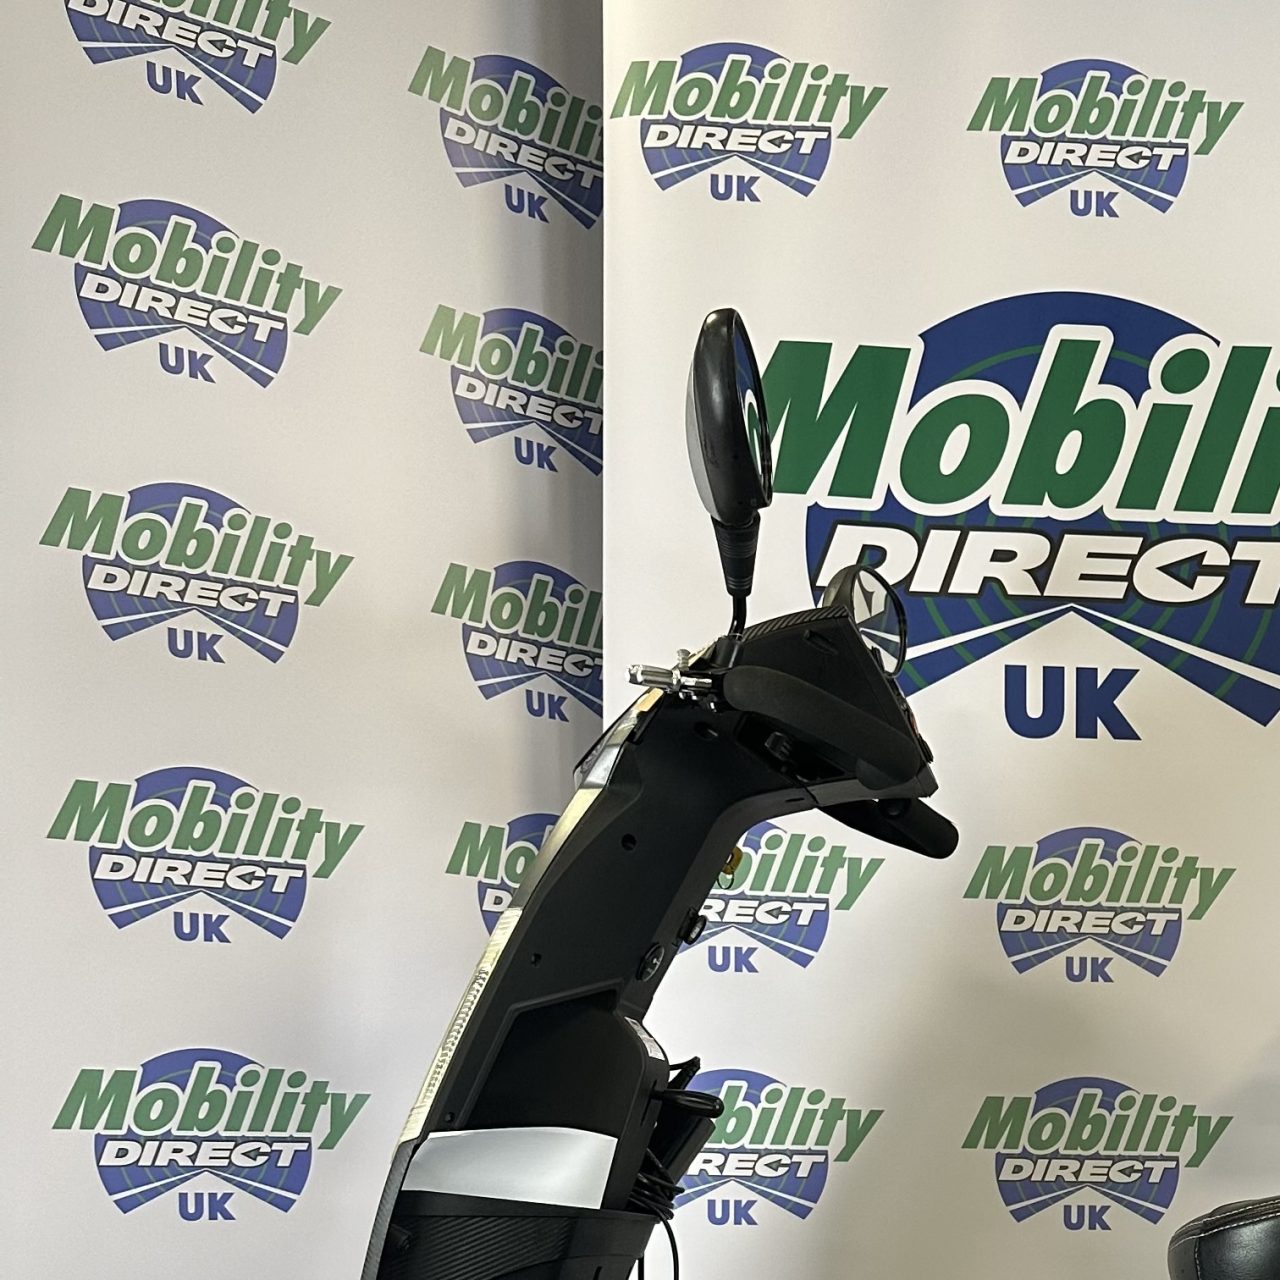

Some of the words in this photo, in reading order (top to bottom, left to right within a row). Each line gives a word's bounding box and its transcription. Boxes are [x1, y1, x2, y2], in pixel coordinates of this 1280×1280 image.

[146, 60, 204, 107] UK
[406, 46, 603, 160] Mobili
[606, 57, 890, 139] Mobility
[968, 74, 1246, 155] Mobility
[443, 114, 603, 191] DIRECT
[644, 121, 829, 155] DIRECT
[1005, 137, 1186, 171] DIRECT
[504, 183, 550, 224] UK
[710, 174, 761, 203] UK
[1070, 190, 1119, 218] UK
[32, 196, 342, 335] Mobility
[80, 270, 284, 343] DIRECT
[158, 342, 216, 384] UK
[418, 305, 603, 404] Mobili
[454, 372, 603, 437] DIRECT
[514, 436, 558, 473] UK
[37, 486, 354, 606] Mobility
[87, 560, 295, 618] DIRECT
[430, 563, 602, 648] Mobil
[167, 627, 225, 664] UK
[466, 628, 602, 683] DIREC
[525, 689, 569, 723] UK
[1004, 664, 1143, 742] UK
[44, 779, 364, 878] Mobility
[93, 850, 303, 893] DIRECT
[965, 842, 1238, 920] Mobility
[173, 912, 231, 944] UK
[698, 899, 827, 926] RECT
[1001, 905, 1180, 936] DIRECT
[708, 945, 759, 973] UK
[1065, 956, 1114, 984] UK
[50, 1065, 370, 1149] Mobility
[708, 1085, 885, 1162] bility
[963, 1091, 1236, 1168] Mobility
[98, 1137, 308, 1167] DIRECT
[687, 1153, 826, 1178] RECT
[999, 1155, 1177, 1184] DIRECT
[178, 1192, 236, 1221] UK
[707, 1199, 758, 1226] UK
[1063, 1205, 1112, 1231] UK
